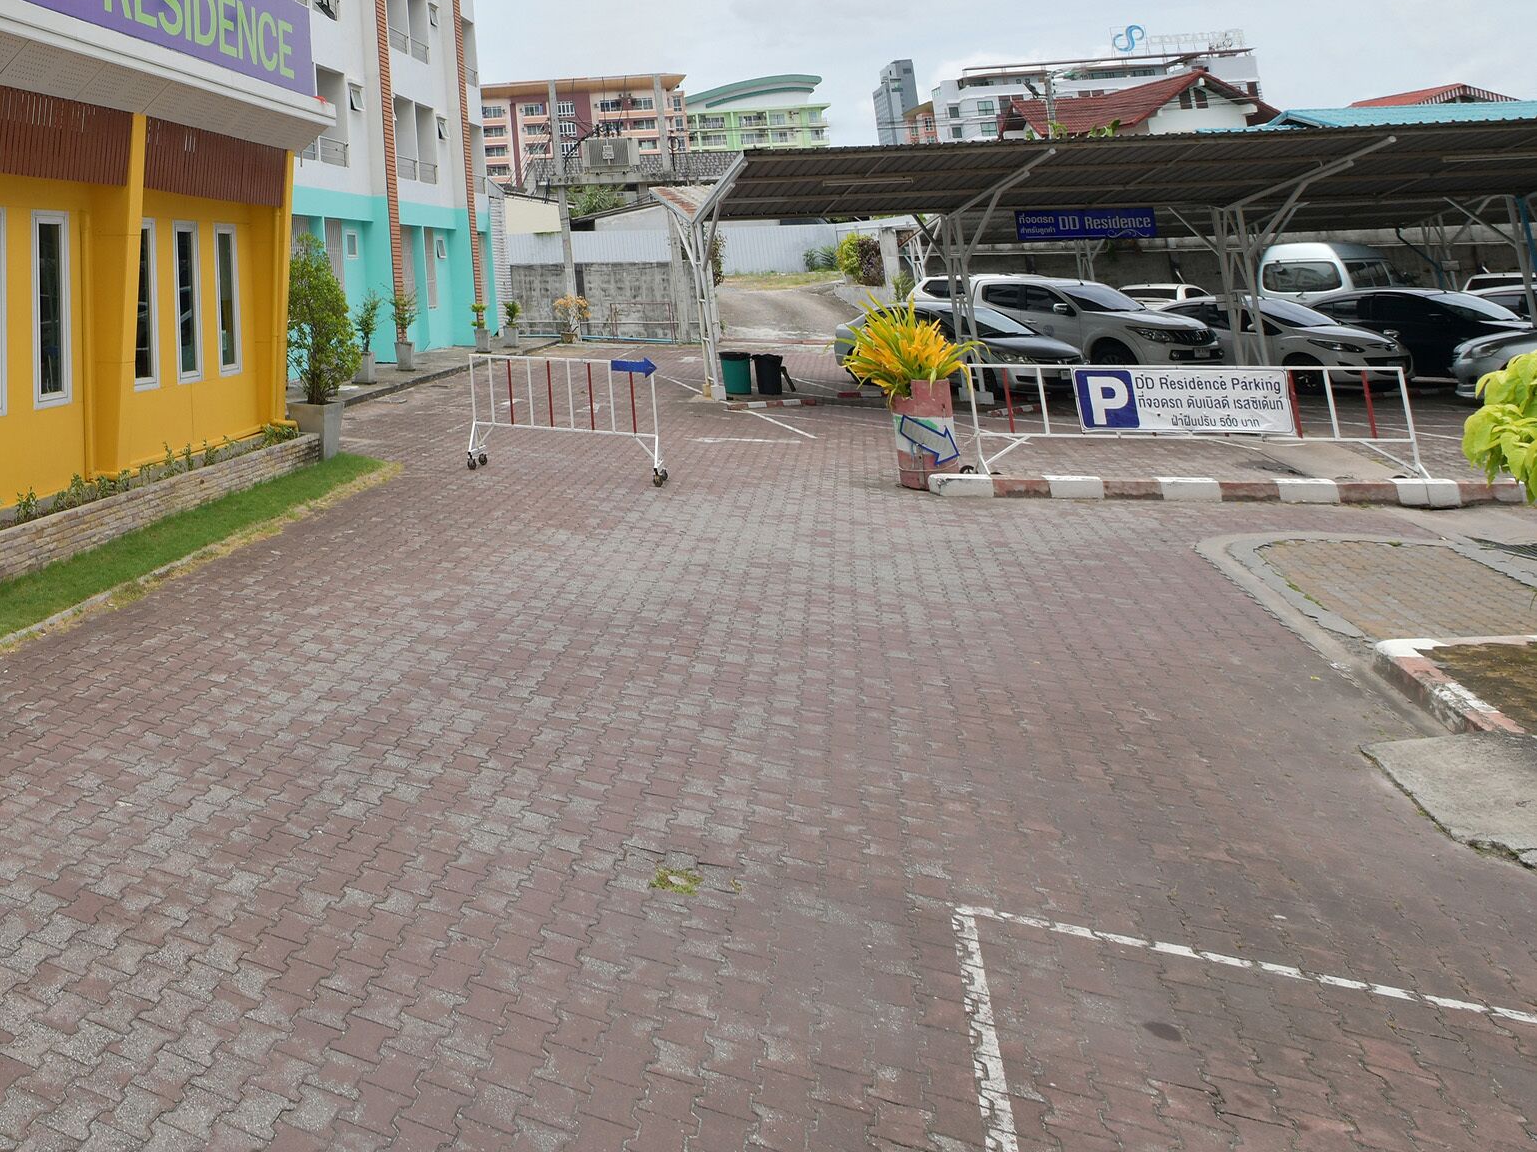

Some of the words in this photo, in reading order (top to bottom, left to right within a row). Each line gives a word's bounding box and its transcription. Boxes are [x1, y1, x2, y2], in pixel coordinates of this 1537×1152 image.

[1018, 213, 1055, 224] ที่จอดรถ
[1058, 215, 1080, 230] DD
[1084, 216, 1152, 230] Residence
[1135, 376, 1155, 390] DD
[1159, 377, 1227, 390] Residence
[1231, 377, 1281, 394] Parking
[1086, 376, 1129, 426] P
[1138, 391, 1183, 409] ที่จอดรถ
[1220, 416, 1238, 427] 500
[1241, 417, 1260, 428] บาท
